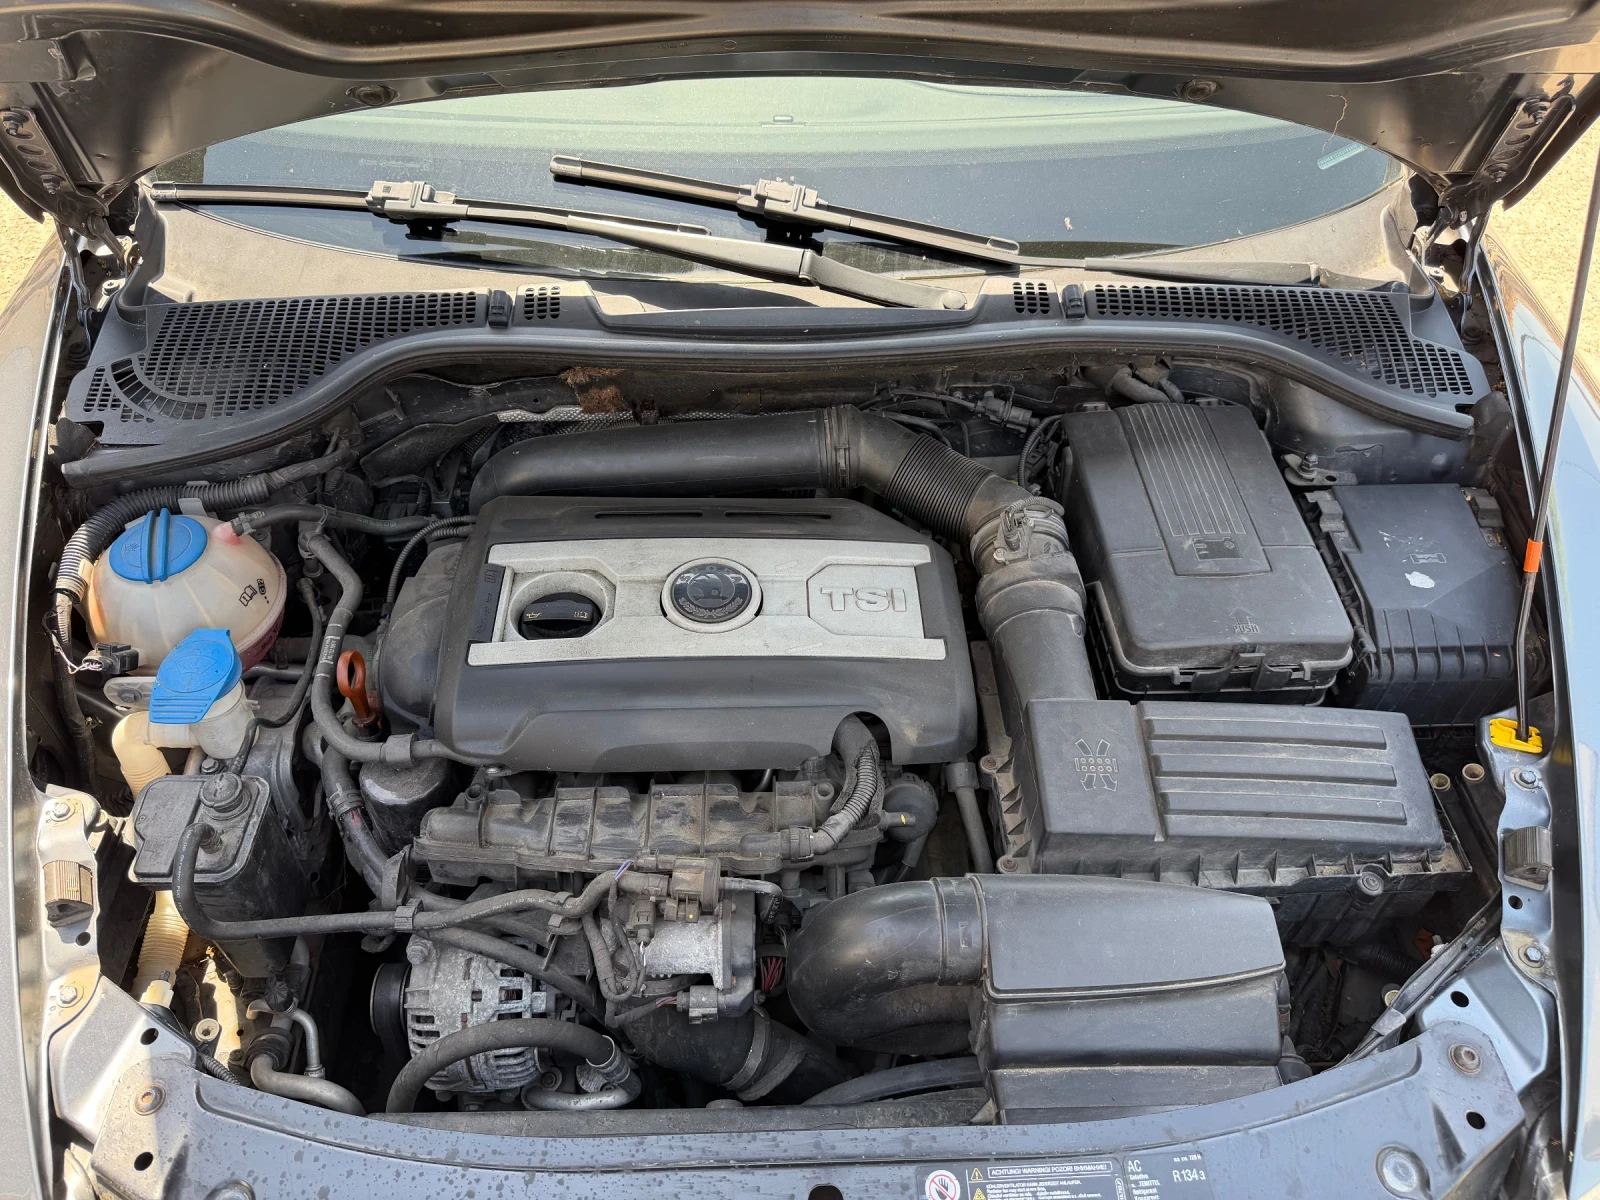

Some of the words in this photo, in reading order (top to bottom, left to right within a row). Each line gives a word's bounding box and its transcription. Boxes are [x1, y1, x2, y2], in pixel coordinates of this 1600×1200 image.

[820, 586, 908, 612] TSI
[1231, 624, 1260, 634] PUSH
[1128, 1159, 1142, 1172] AC
